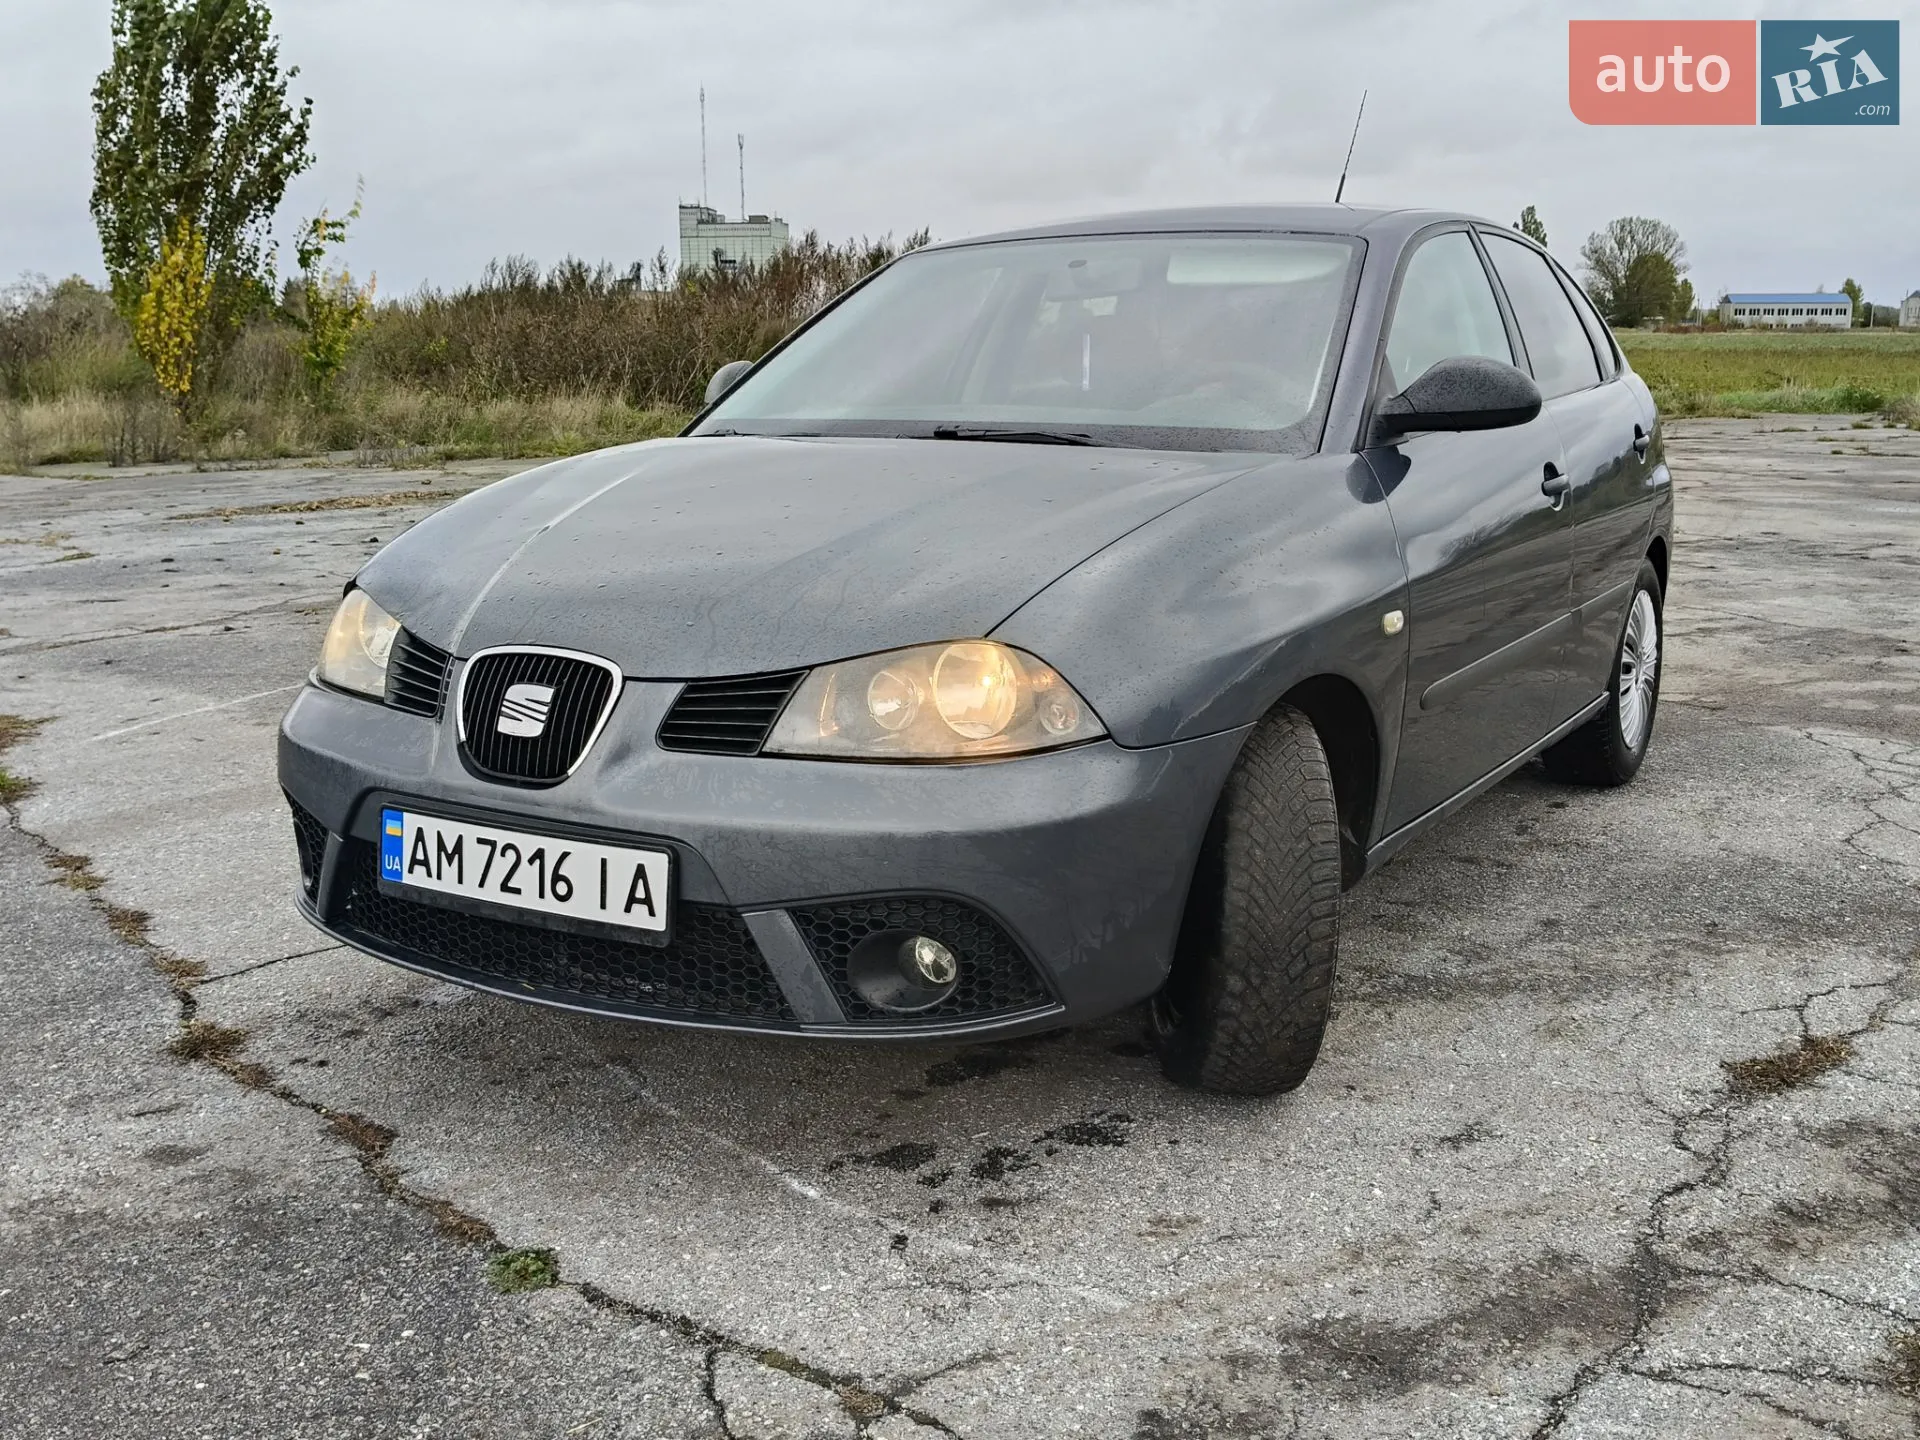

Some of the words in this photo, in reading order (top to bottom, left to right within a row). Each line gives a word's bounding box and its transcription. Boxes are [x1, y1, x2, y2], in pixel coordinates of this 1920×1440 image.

[385, 854, 402, 873] UA
[407, 826, 464, 885] AM
[476, 837, 574, 903] 7216
